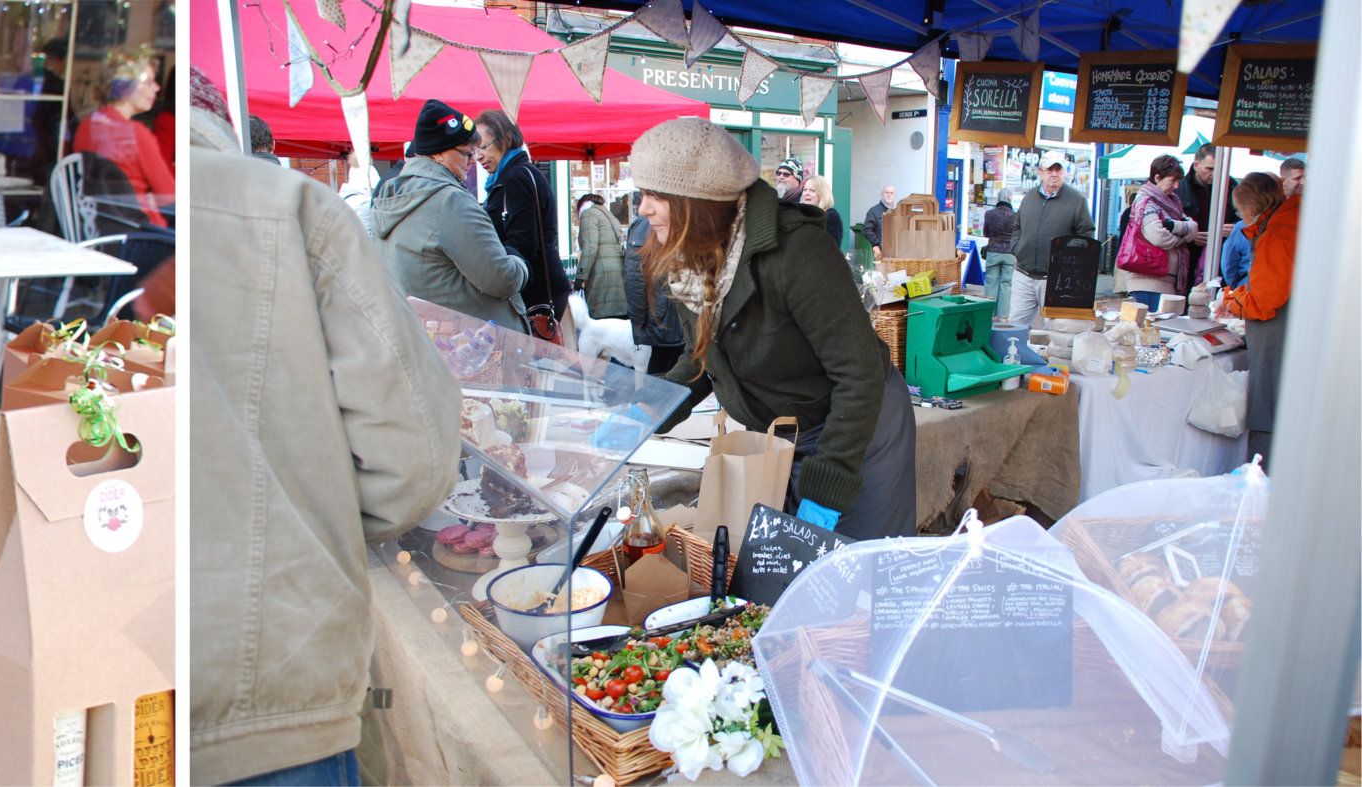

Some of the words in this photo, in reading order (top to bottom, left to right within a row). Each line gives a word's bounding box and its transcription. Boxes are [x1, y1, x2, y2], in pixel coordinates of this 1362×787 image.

[642, 68, 770, 95] PRESENTIS
[976, 78, 998, 87] CUCINA
[1092, 69, 1132, 84] HOMEMADE
[1136, 70, 1173, 84] GOODIES
[972, 88, 1017, 109] SORELLA
[1048, 93, 1070, 105] store
[1236, 99, 1277, 109] MELI-MELO
[1235, 109, 1264, 119] BERBER
[1233, 119, 1271, 129] COLESLAW
[1011, 147, 1040, 169] Keep
[782, 520, 818, 546] SALADS
